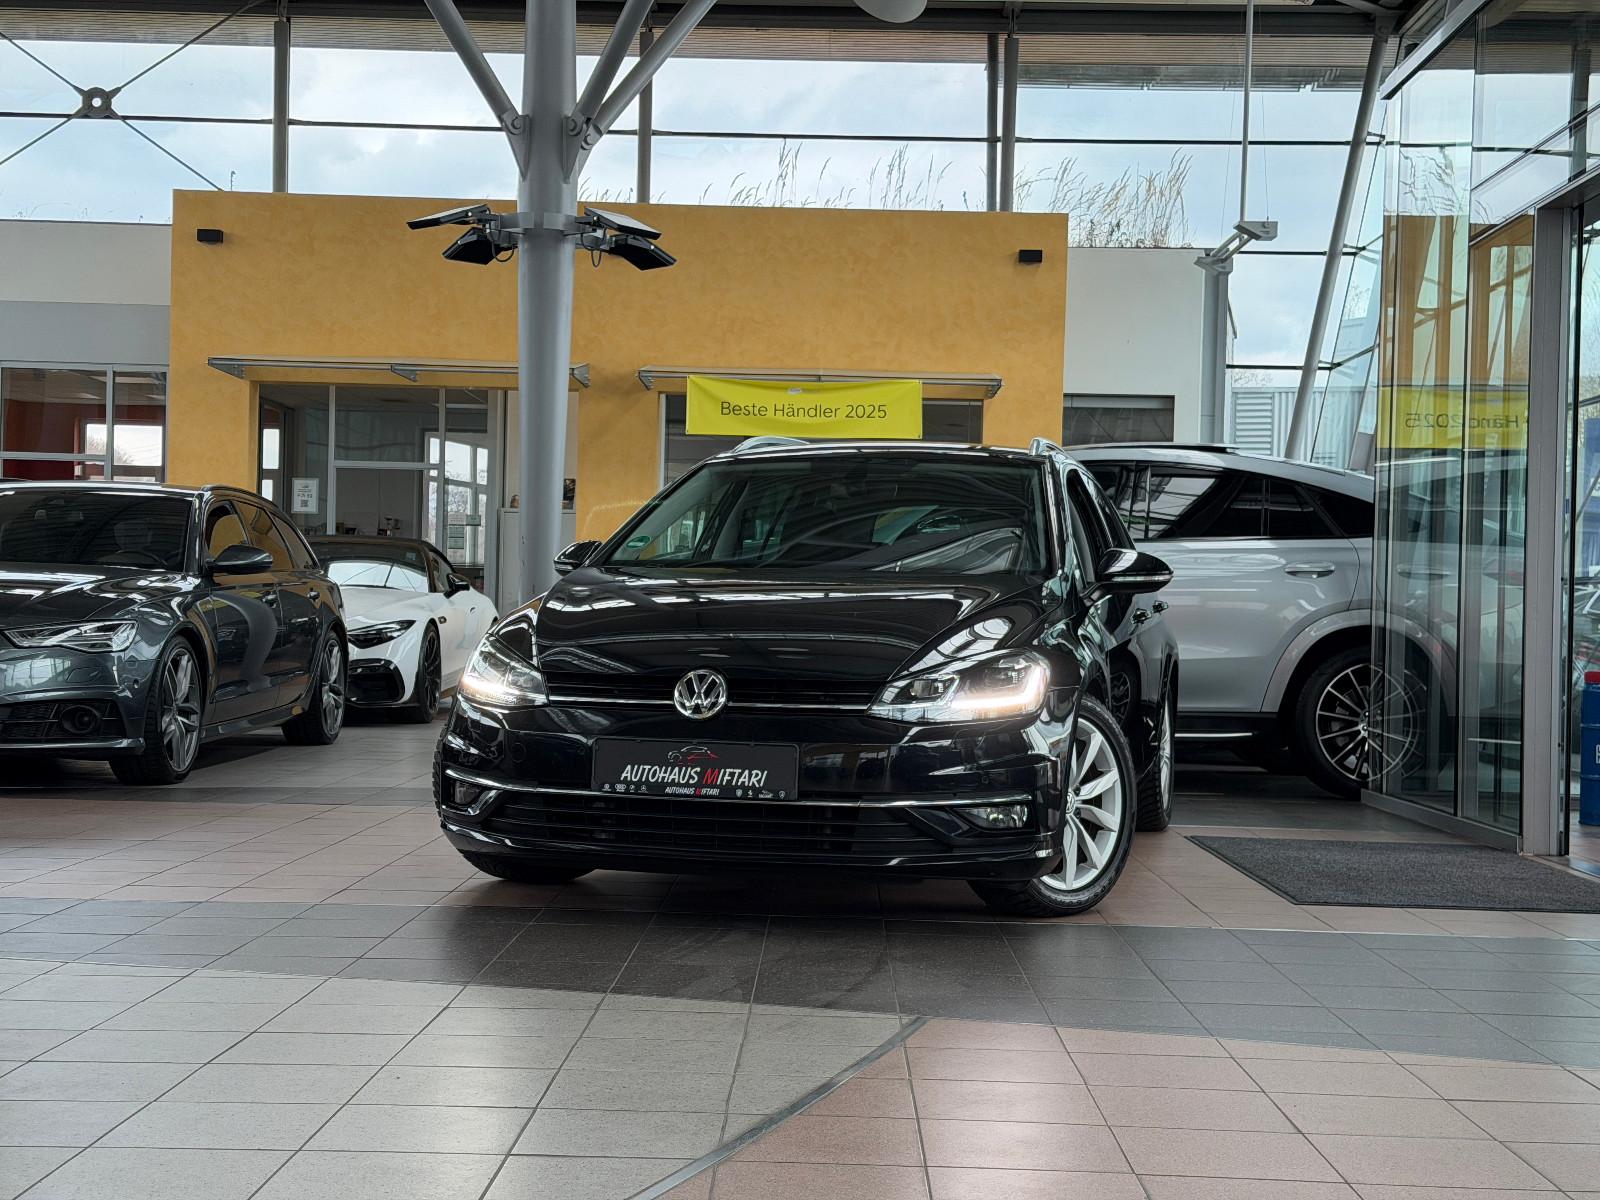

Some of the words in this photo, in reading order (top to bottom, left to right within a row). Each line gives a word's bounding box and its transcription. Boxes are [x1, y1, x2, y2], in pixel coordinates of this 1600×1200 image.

[720, 401, 768, 417] Beste
[773, 402, 840, 419] Händler
[844, 403, 888, 419] 2025
[620, 764, 701, 784] AUTOHAUS
[702, 767, 768, 788] MIFTARI
[664, 786, 695, 796] AUTOHAUS
[695, 787, 720, 797] MIFTARI
